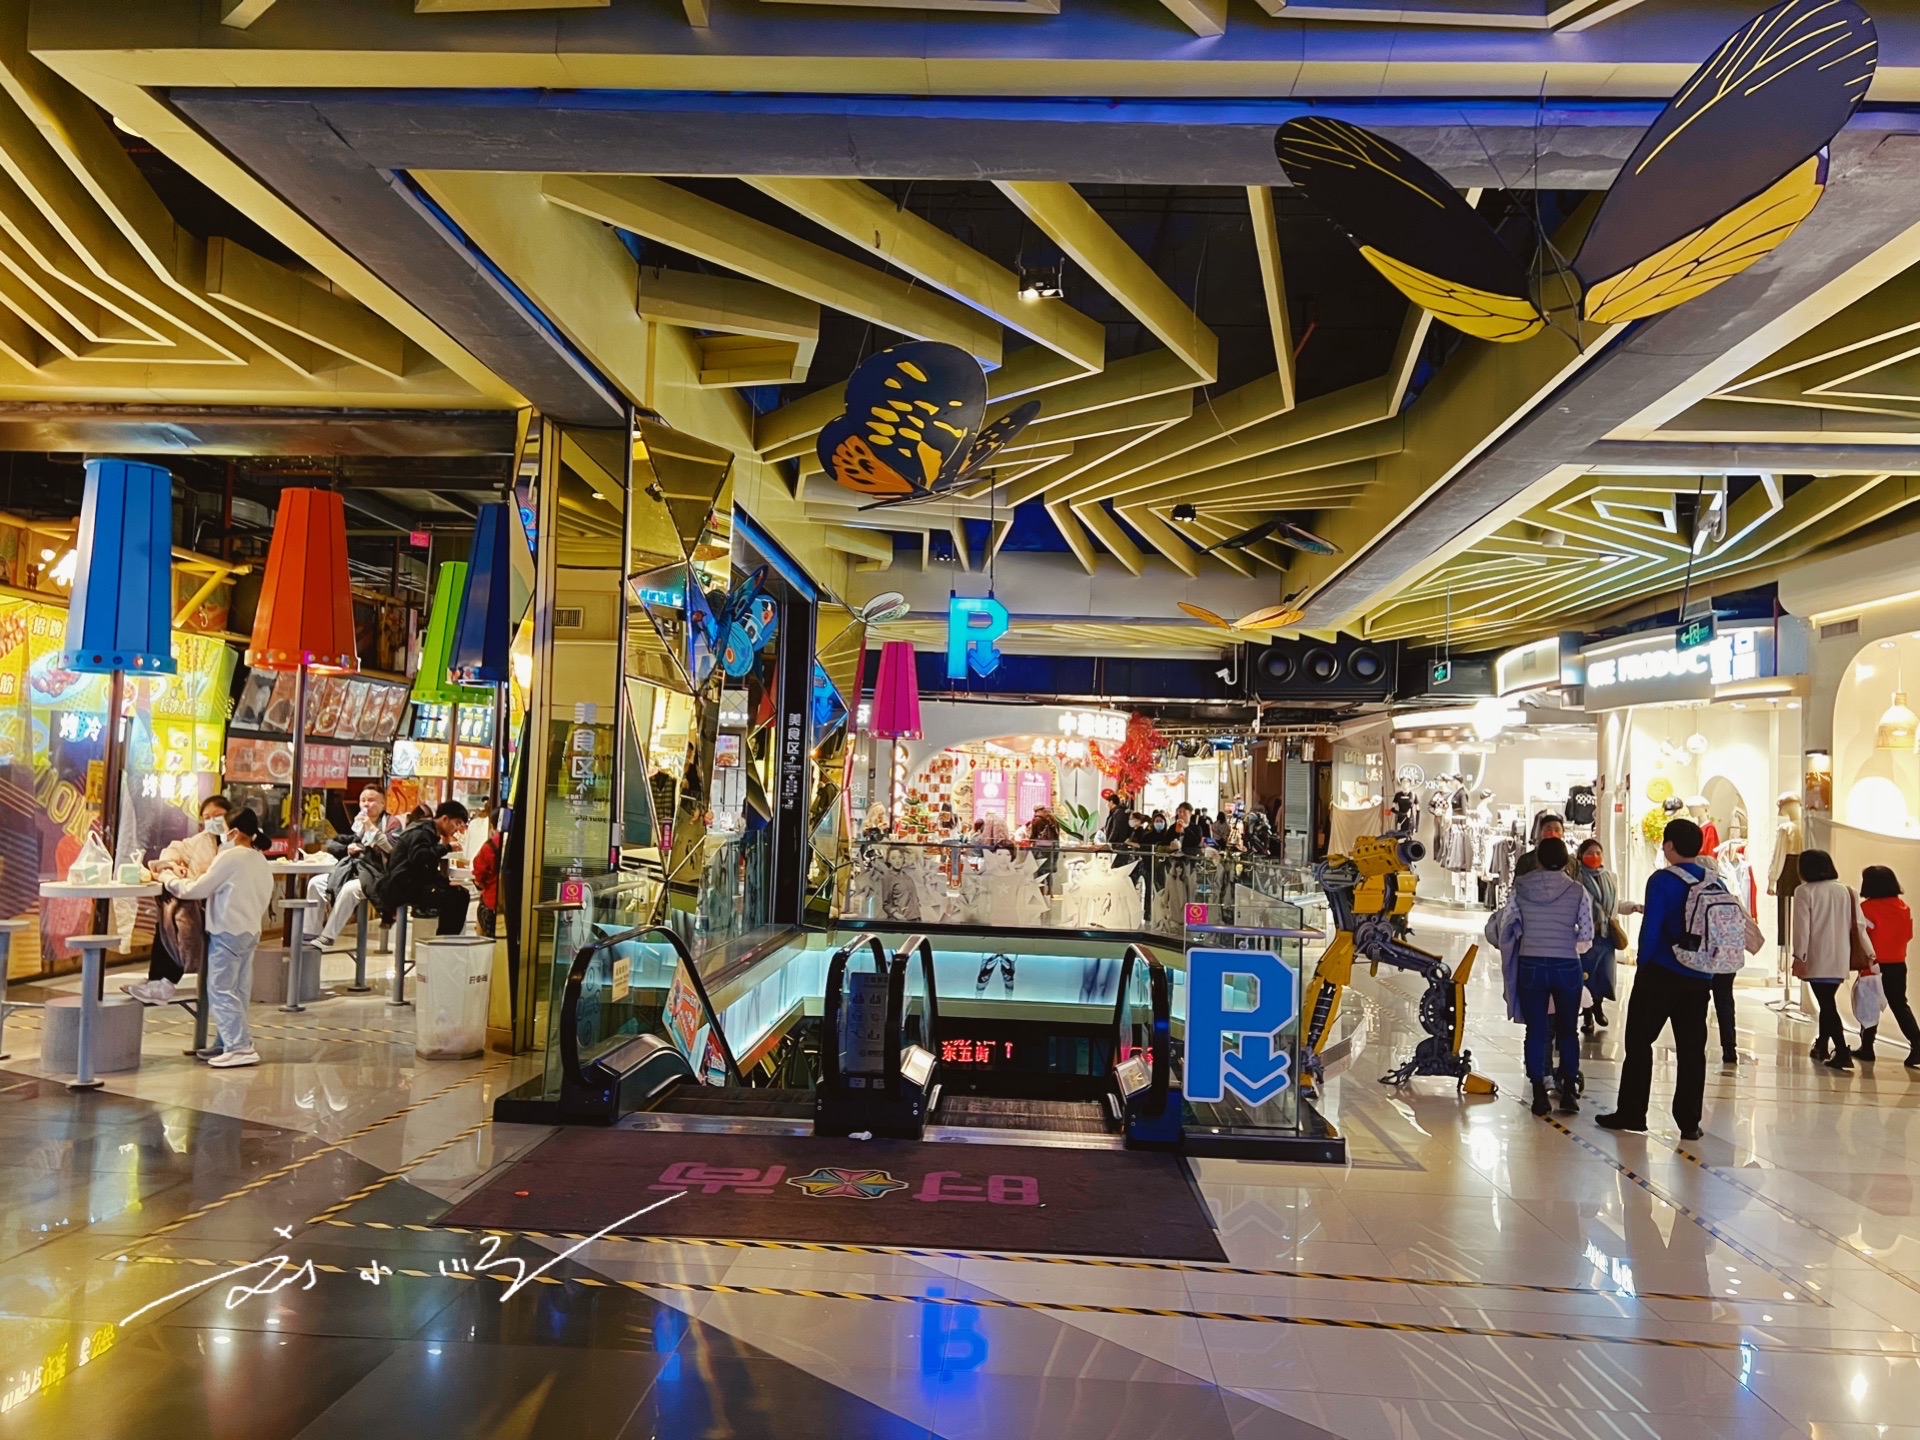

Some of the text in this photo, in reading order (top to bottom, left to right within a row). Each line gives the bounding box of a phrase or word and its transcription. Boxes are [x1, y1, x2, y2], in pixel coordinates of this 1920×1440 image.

[786, 713, 801, 755] 美食区
[1184, 948, 1297, 1102] P
[942, 1043, 990, 1063] 东五街
